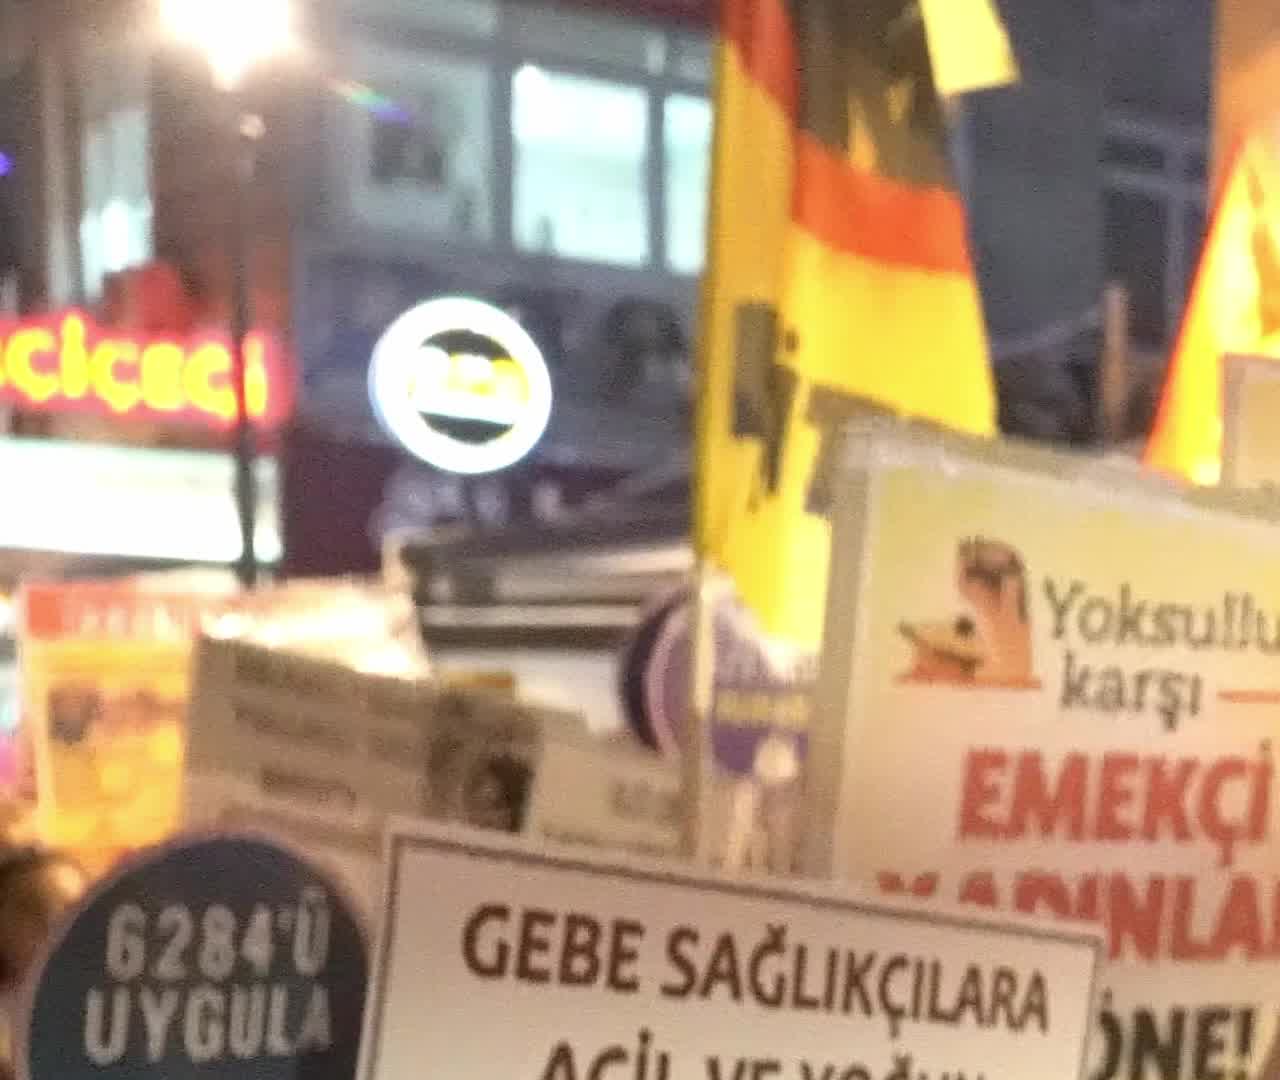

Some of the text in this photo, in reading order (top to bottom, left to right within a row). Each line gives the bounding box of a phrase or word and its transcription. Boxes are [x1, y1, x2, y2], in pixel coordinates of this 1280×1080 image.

[1060, 650, 1203, 733] karşı
[957, 737, 1275, 868] EMEKÇİ
[105, 886, 331, 981] 6284'Ü
[461, 903, 1051, 1040] GEBE SAĞLIKÇILARA
[84, 982, 332, 1065] UYGULA
